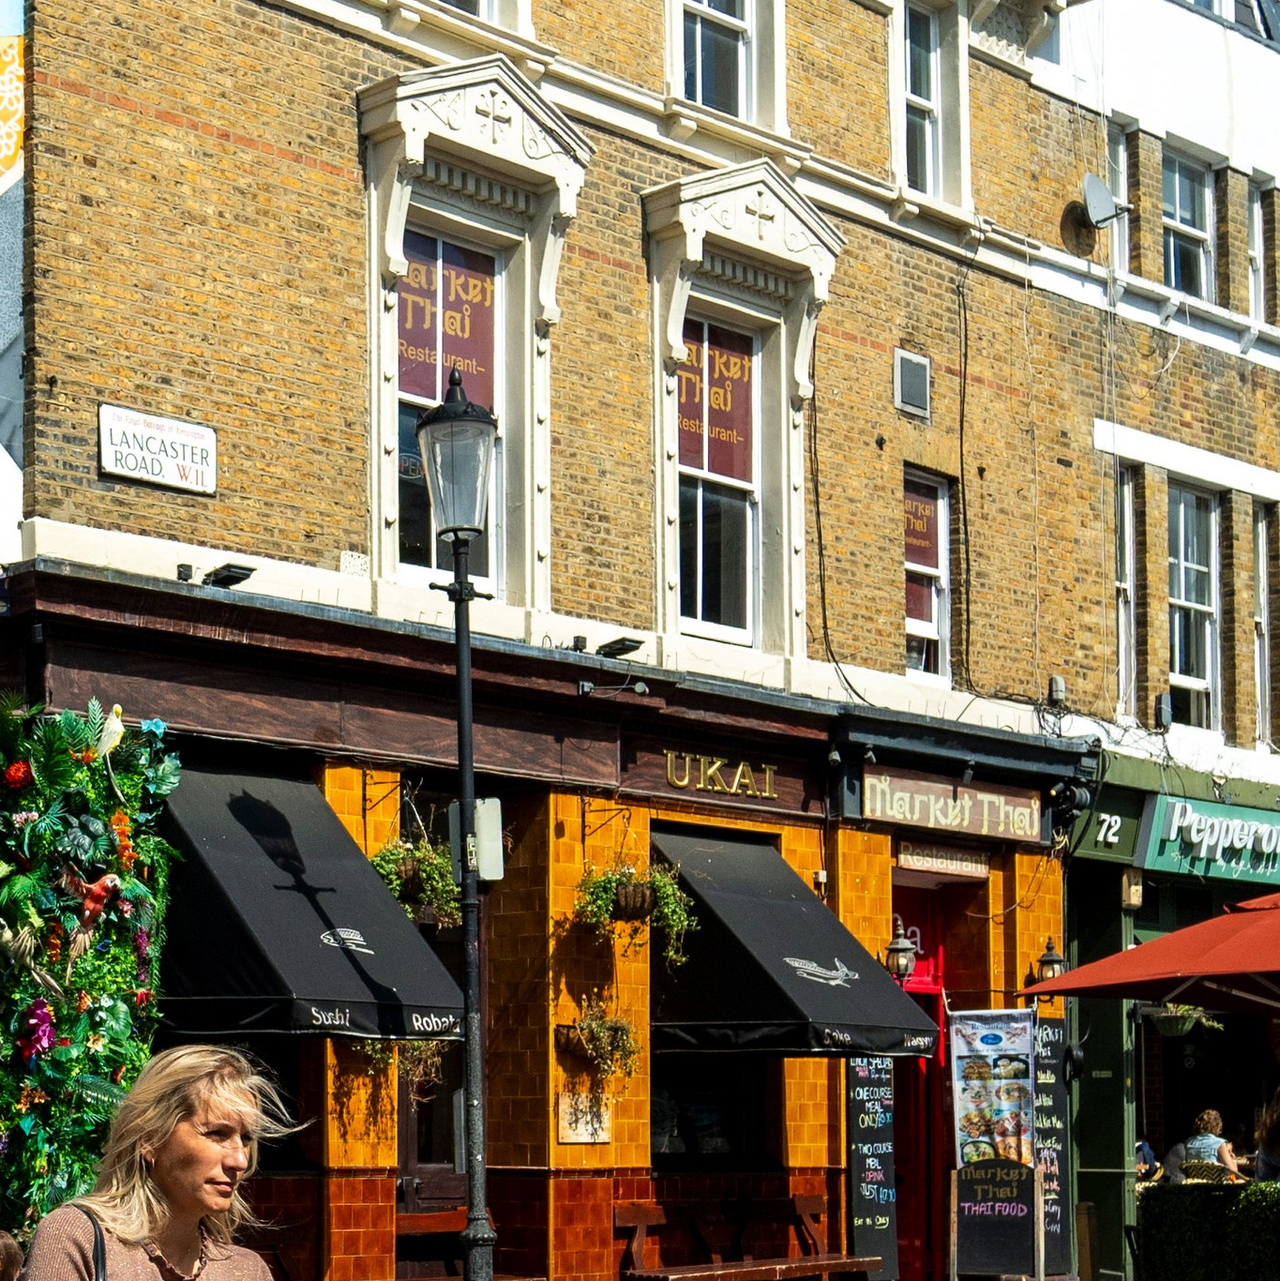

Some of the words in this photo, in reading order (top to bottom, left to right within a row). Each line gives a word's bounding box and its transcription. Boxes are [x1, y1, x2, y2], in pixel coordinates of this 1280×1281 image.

[403, 263, 494, 307] arket
[684, 342, 752, 383] arket
[109, 427, 209, 467] LANCASTER
[114, 450, 165, 478] ROAD.
[663, 749, 779, 799] UKAI
[865, 775, 973, 828] Market
[977, 793, 1040, 837] Thai
[1097, 813, 1122, 844] 72
[1167, 798, 1280, 860] Peppero
[900, 841, 987, 874] Restaurant
[311, 1007, 350, 1027] Sushi
[412, 1013, 461, 1033] Robata
[865, 1101, 884, 1113] MEAL
[859, 1113, 878, 1130] ONLY
[858, 1143, 872, 1155] TWO
[961, 1164, 1029, 1182] Market
[860, 1183, 878, 1202] JUST
[974, 1181, 1018, 1200] Thai
[960, 1201, 994, 1216] THAI
[994, 1201, 1028, 1217] FOOD
